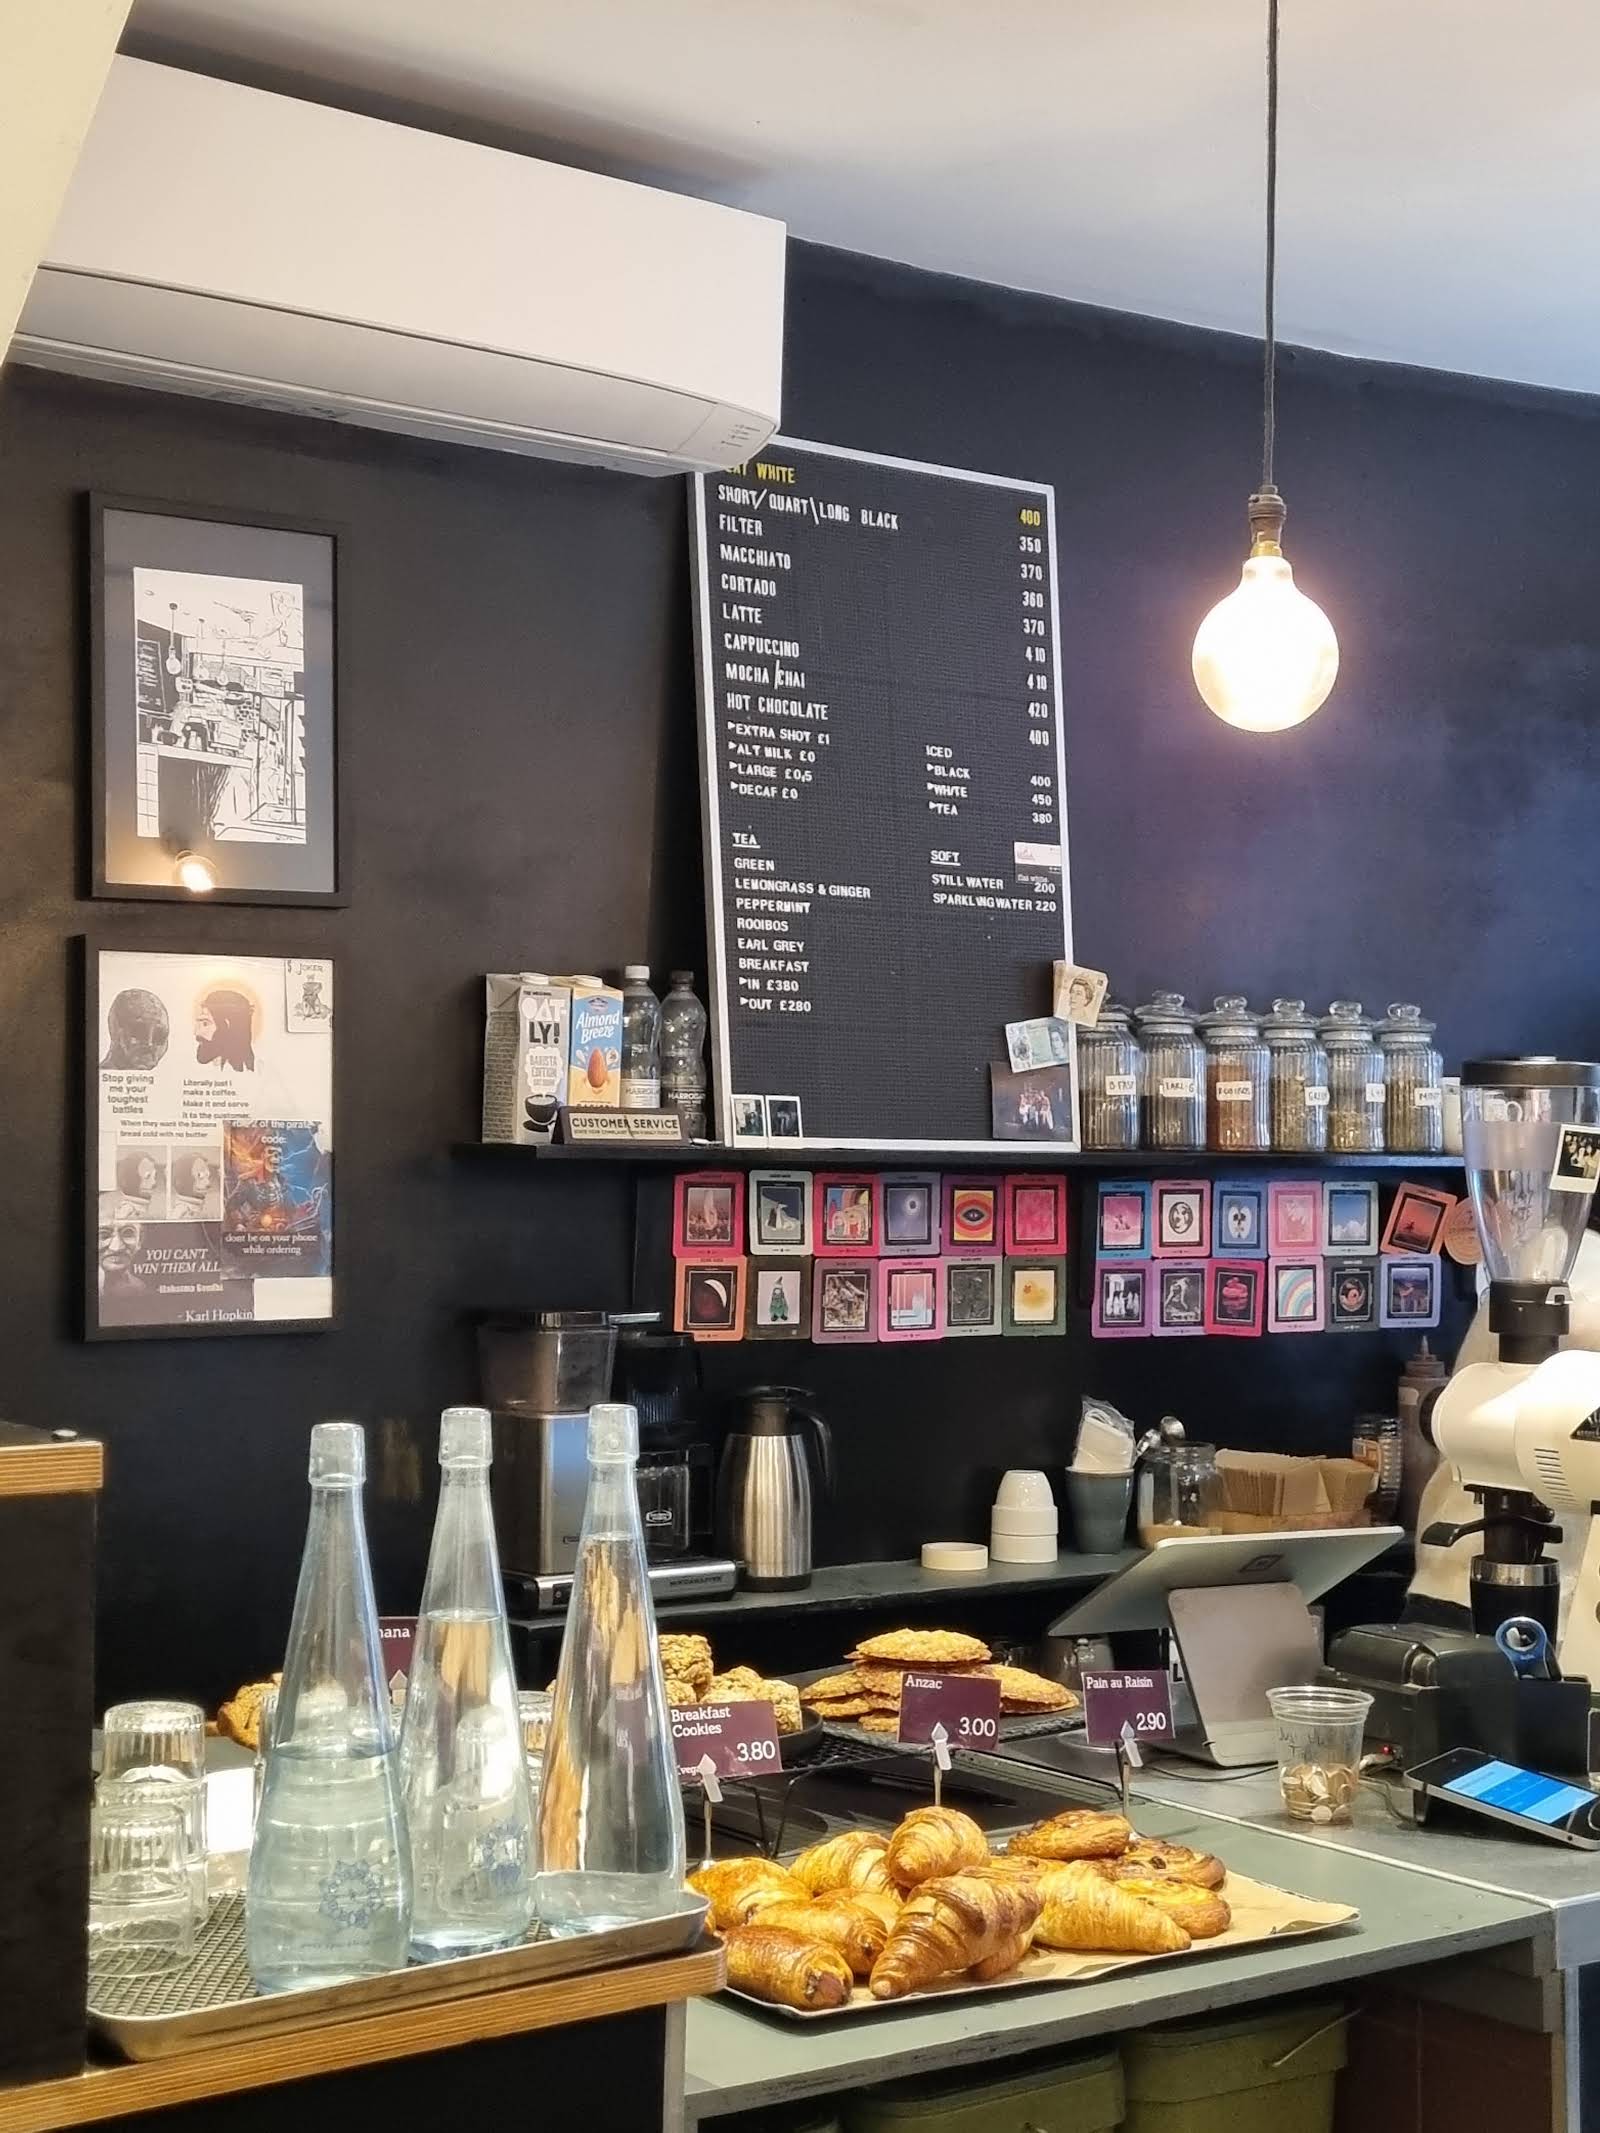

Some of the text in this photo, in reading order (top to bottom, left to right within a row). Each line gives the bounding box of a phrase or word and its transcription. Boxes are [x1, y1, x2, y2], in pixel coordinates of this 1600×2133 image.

[756, 463, 796, 483] WHITE
[1020, 509, 1041, 526] 400
[861, 508, 898, 530] BLACK
[1019, 536, 1041, 554] 350
[719, 514, 1042, 581] FILTER 370
[720, 543, 1044, 608] MACCHIATO 360
[721, 573, 1045, 636] CORTADO 370
[723, 603, 762, 624] LATTE
[724, 633, 800, 657] CAPPUCCINO
[725, 662, 769, 683] MOCHA
[1028, 702, 1048, 718] 420
[726, 692, 1049, 746] HOT CHOCOLATE 400
[736, 723, 829, 745] EXTRA SHOT £1
[737, 744, 761, 756] ALT
[764, 746, 792, 760] MILK
[925, 744, 952, 758] ICED
[737, 763, 777, 778] LARGE
[934, 764, 1051, 787] BLACK 400
[738, 783, 778, 798] DECAF
[933, 784, 1052, 806] WHITE 450
[936, 803, 1053, 824] TEA 380
[732, 832, 758, 845] TEA
[734, 857, 775, 871] GREEN
[930, 850, 960, 862] SOFT
[735, 878, 871, 899] LEMONGRASS & GINGER
[931, 874, 1056, 894] STILL WATER 200
[736, 897, 811, 913] PEPPERMINT
[933, 892, 1057, 912] SPARKLING WATER 220
[737, 917, 789, 932] ROOIBOS
[737, 937, 805, 952] EARL GREY
[738, 957, 810, 973] BREAKFAST
[748, 978, 800, 992] IN £380
[748, 998, 812, 1012] OUT £280
[575, 1010, 620, 1030] Almond
[529, 1021, 560, 1044] LY!
[581, 1026, 615, 1044] Breeze
[102, 1074, 154, 1085] Stop giving
[183, 1079, 213, 1088] Literally
[109, 1085, 147, 1094] me your
[107, 1095, 149, 1105] toughest
[182, 1100, 204, 1108] Make
[212, 1100, 226, 1108] and
[112, 1105, 144, 1114] battles
[259, 1120, 268, 1128] of
[270, 1120, 285, 1129] the
[572, 1118, 678, 1129] CUSTOMER SERVICE
[247, 1233, 258, 1242] be
[271, 1234, 291, 1244] your
[292, 1233, 318, 1244] phone
[146, 1249, 171, 1261] YOU
[242, 1244, 302, 1255] while ordering
[133, 1263, 158, 1275] WIN
[161, 1262, 196, 1274] THEM
[185, 1309, 209, 1322] Karl
[904, 1674, 943, 1690] Anzac
[1085, 1676, 1154, 1689] Pain au Raisin
[671, 1706, 731, 1723] Breakfast
[1136, 1712, 1166, 1731] 2.90
[672, 1723, 723, 1738] Cookies
[958, 1716, 996, 1737] 3.00
[737, 1740, 776, 1762] 3.80
